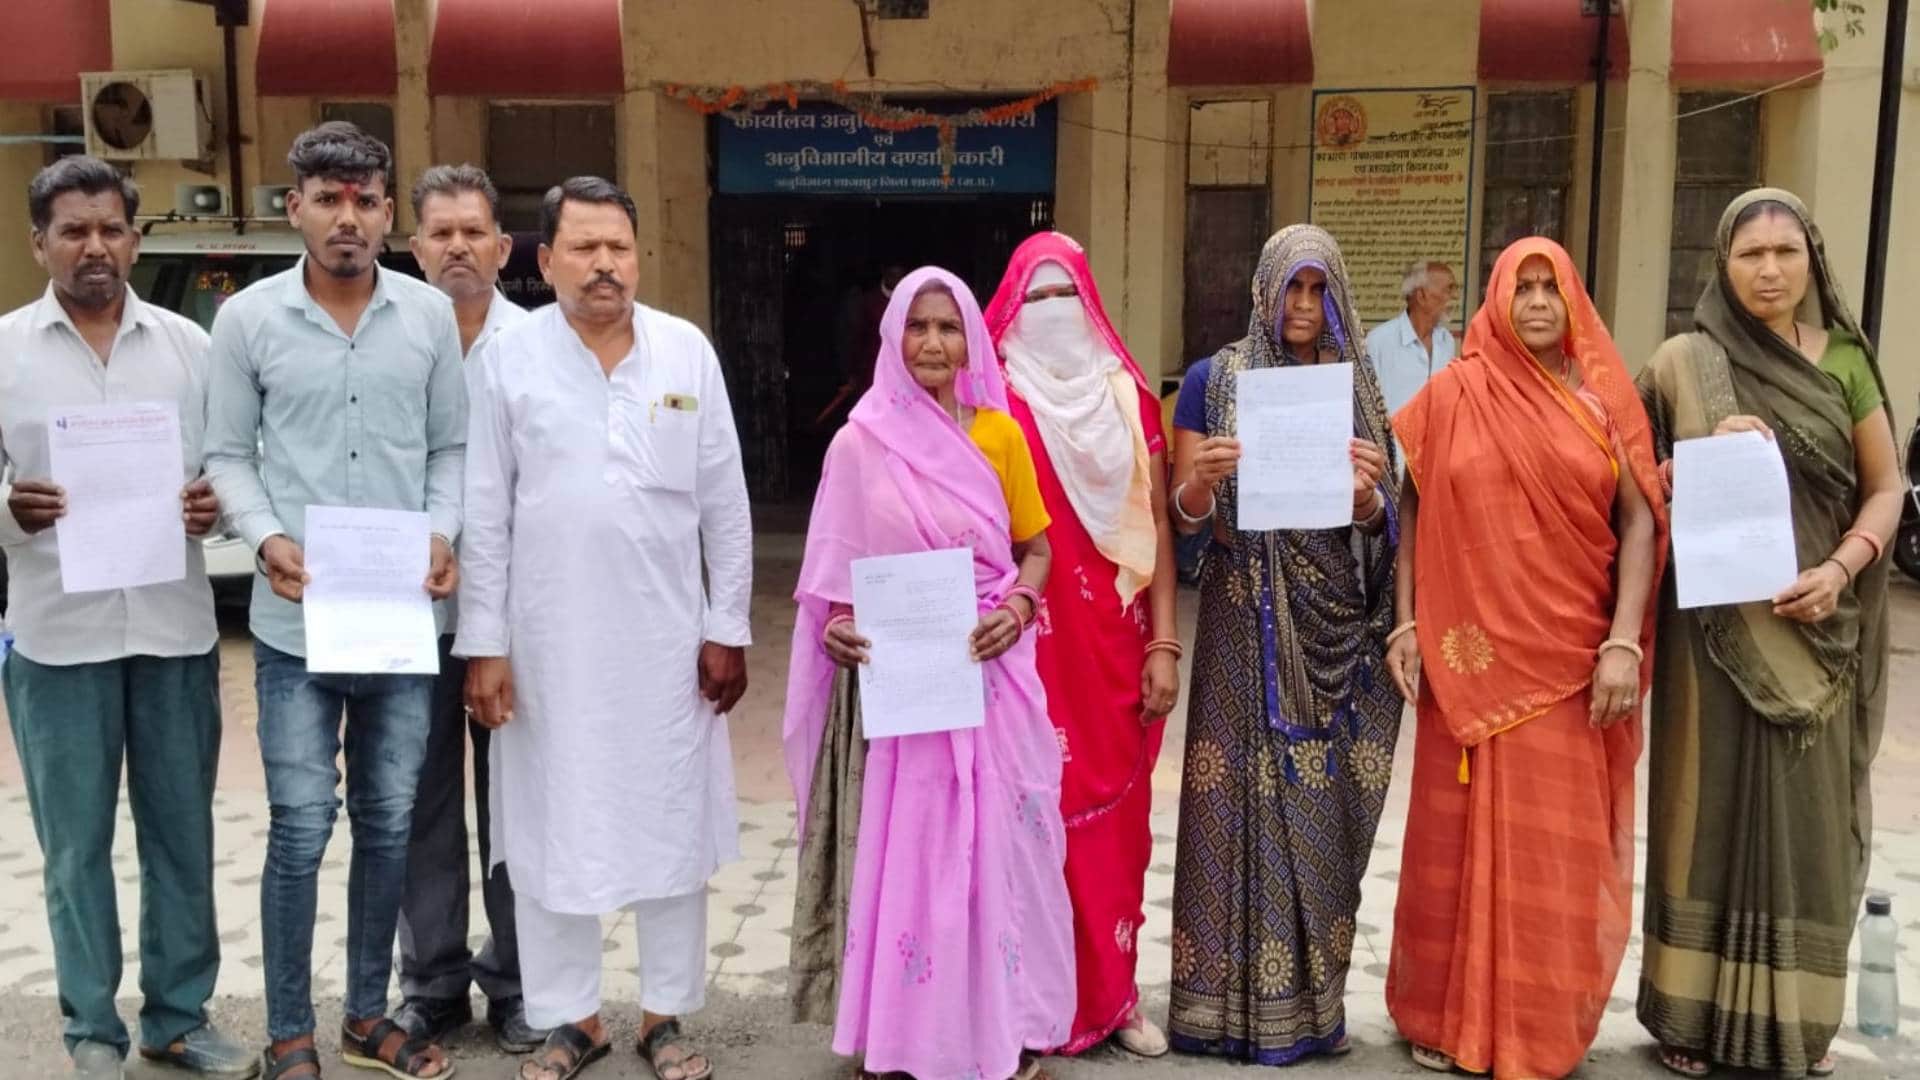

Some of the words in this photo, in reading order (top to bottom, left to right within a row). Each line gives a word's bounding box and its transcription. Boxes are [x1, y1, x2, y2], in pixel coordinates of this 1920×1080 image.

[734, 110, 815, 130] कार्यालय
[873, 131, 894, 147] एवं
[765, 145, 886, 172] अनुविभागीय
[891, 144, 1004, 167] दण्डािकारी
